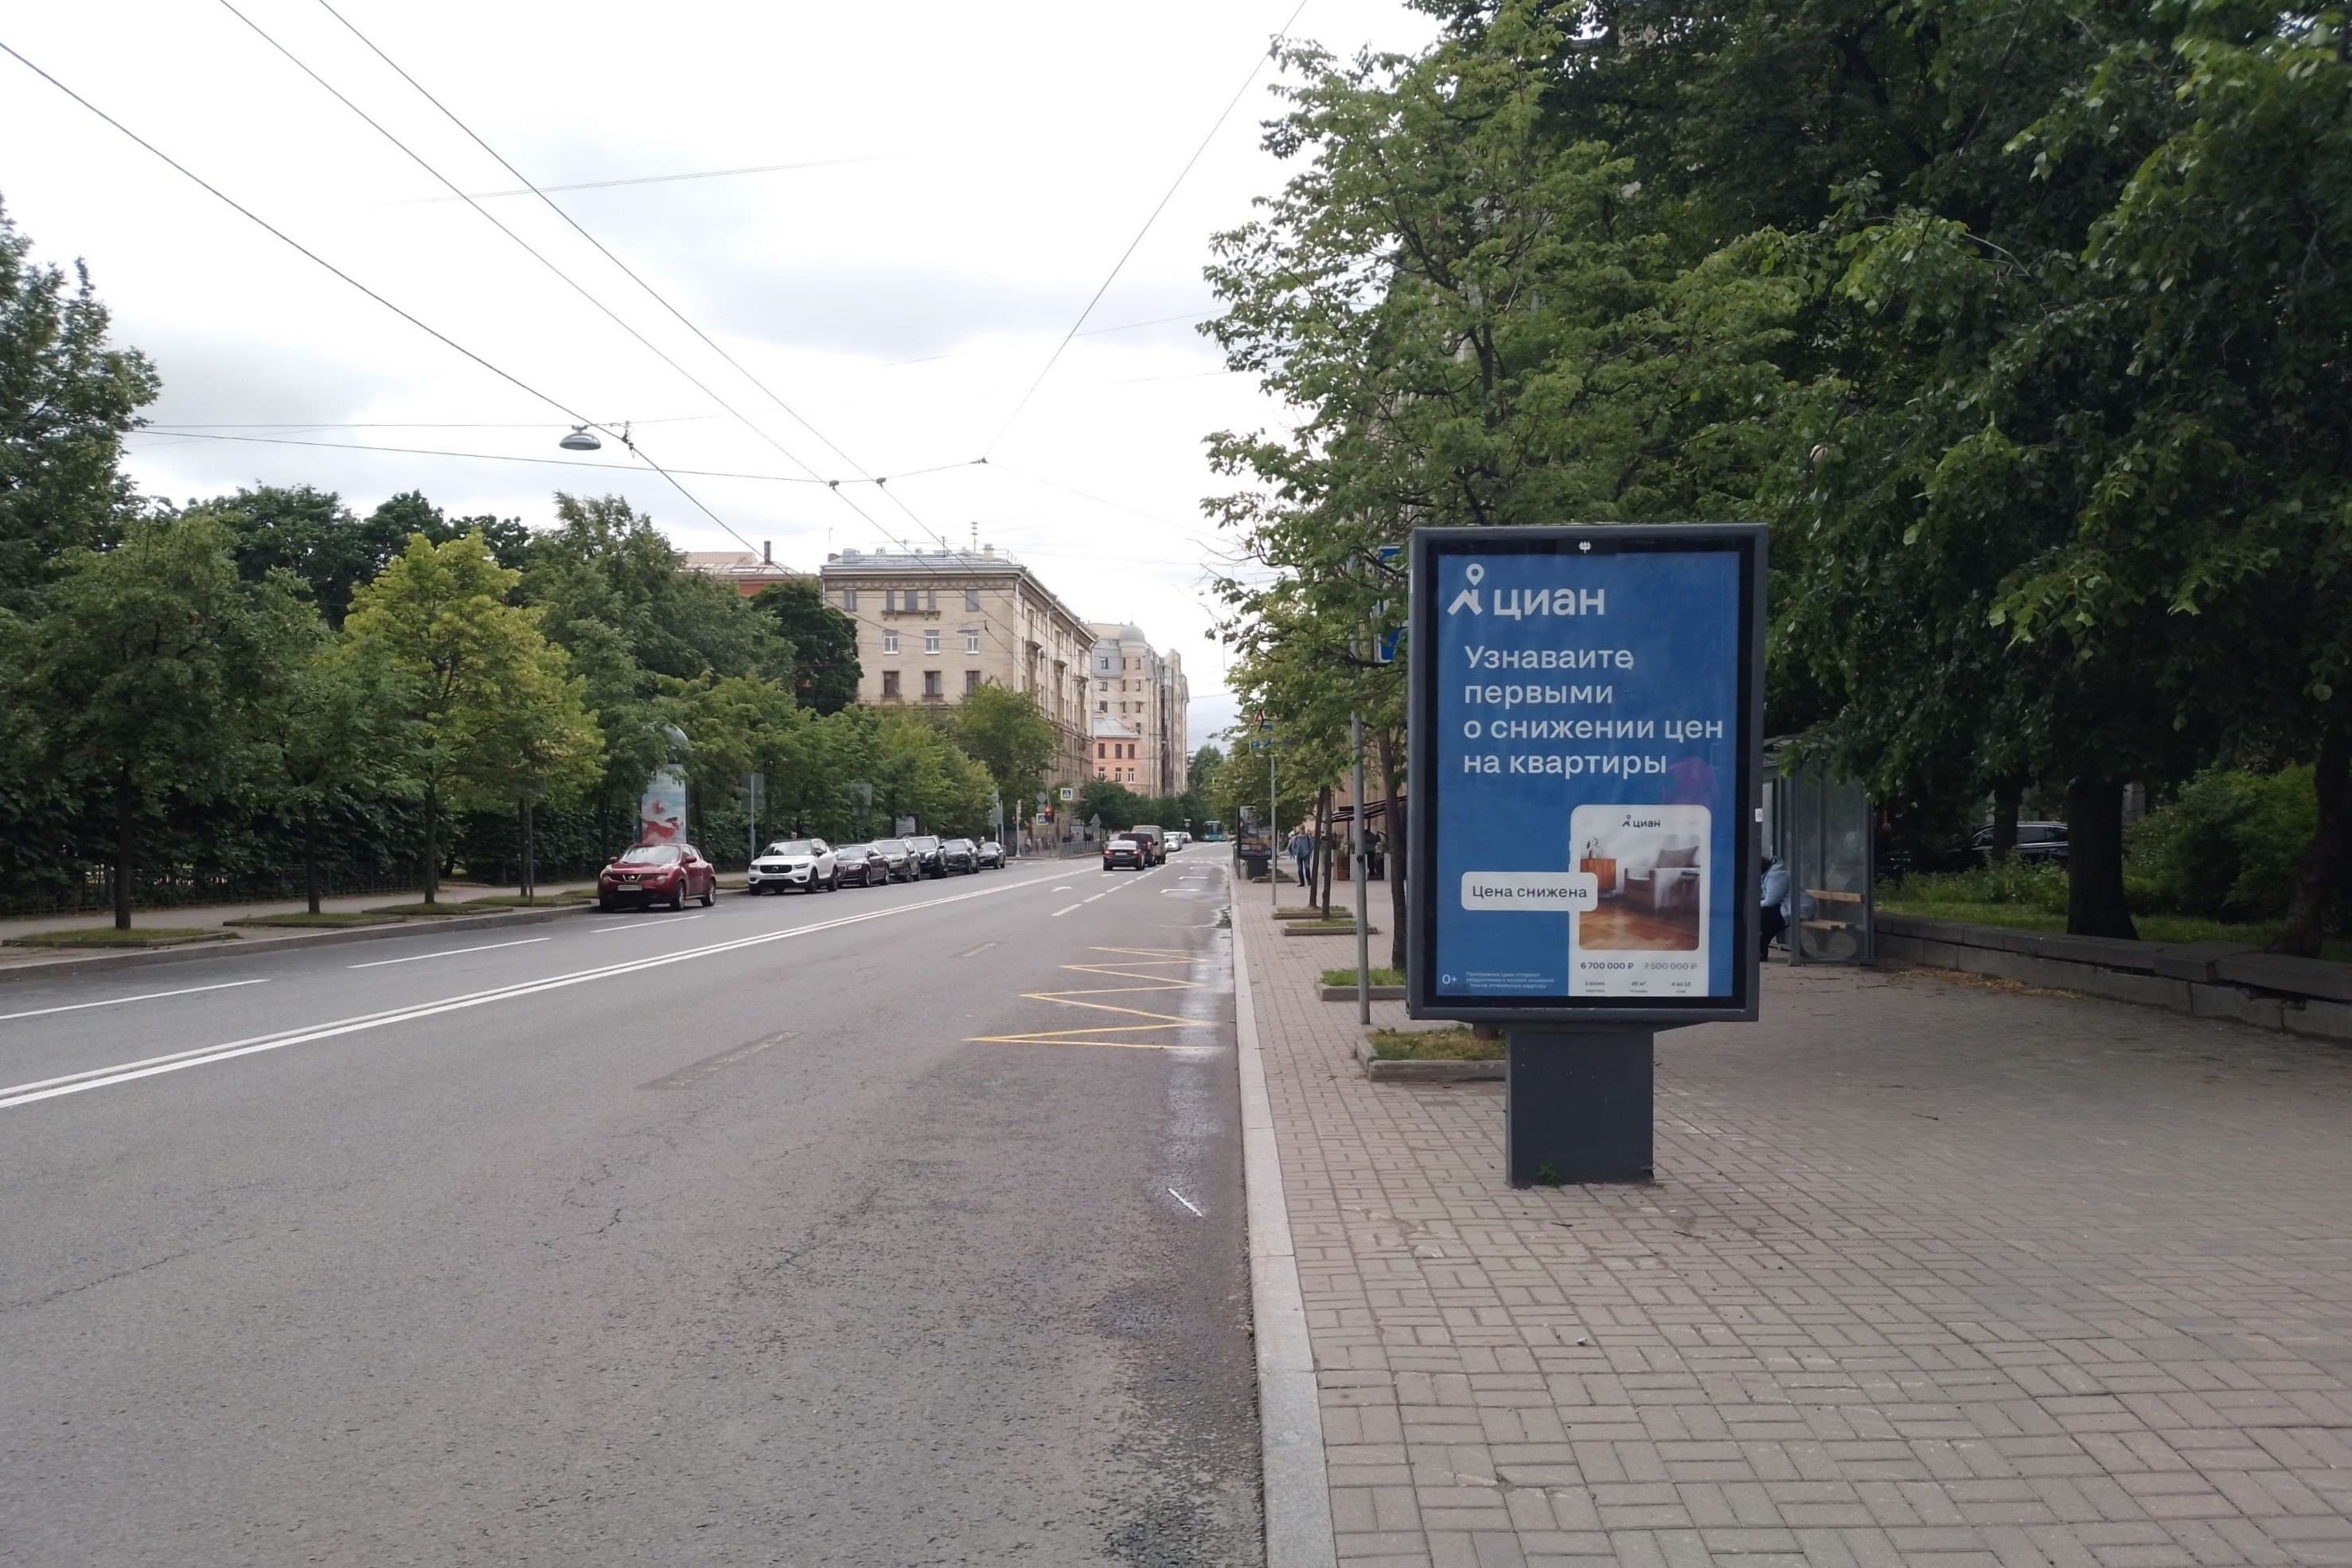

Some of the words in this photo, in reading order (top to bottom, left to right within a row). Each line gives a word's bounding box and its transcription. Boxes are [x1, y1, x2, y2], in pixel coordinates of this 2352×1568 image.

[1493, 588, 1605, 621] циан
[1465, 685, 1613, 709] первыми
[1463, 720, 1482, 739] о
[1490, 720, 1654, 739] снижении
[1664, 720, 1722, 743] цен
[1464, 755, 1501, 774] на
[1509, 755, 1667, 780] квартиры
[1472, 885, 1514, 899] Цена
[1516, 887, 1588, 899] снижена
[1441, 973, 1457, 985] 0+
